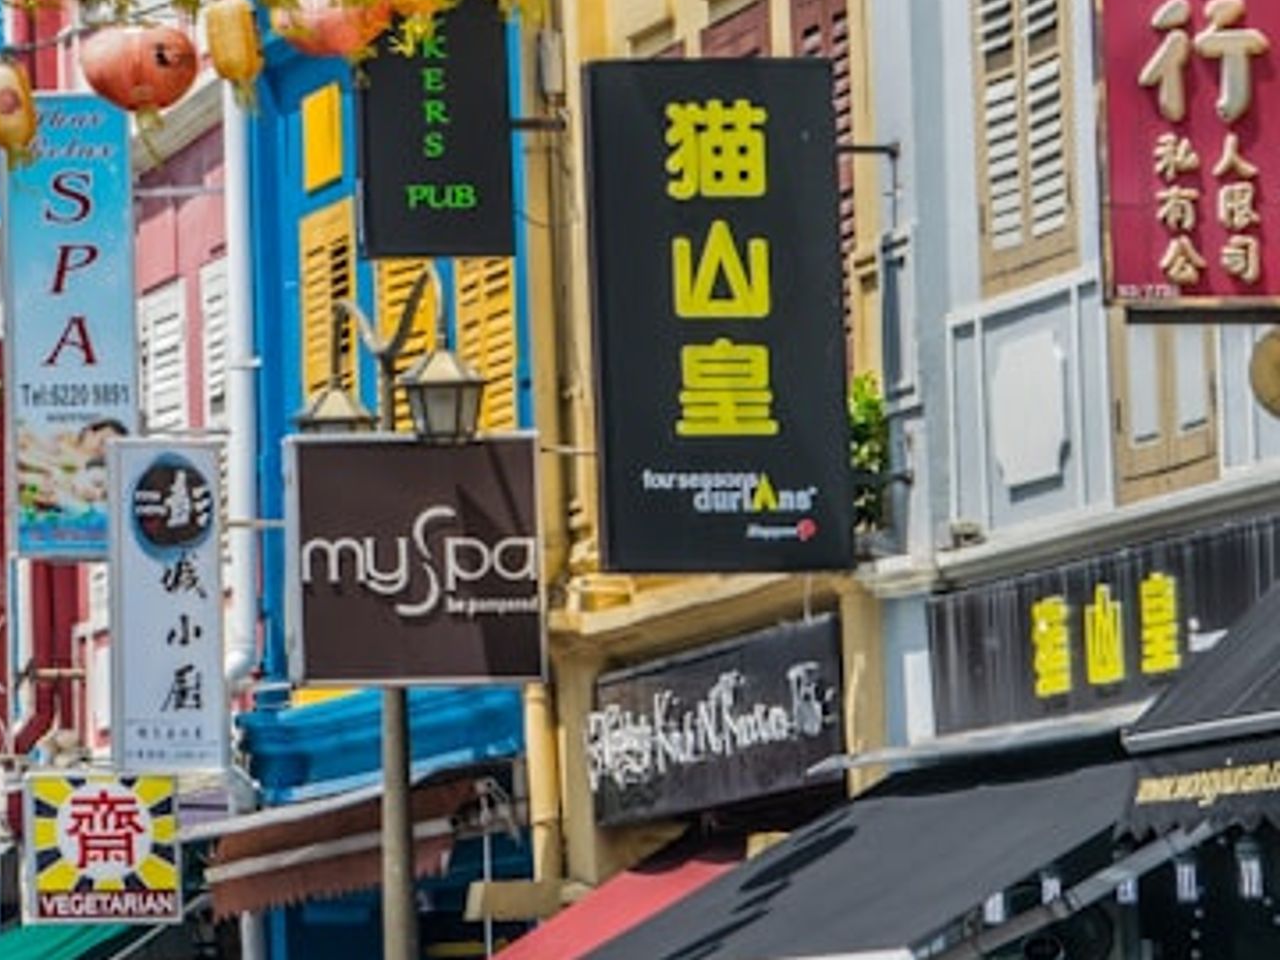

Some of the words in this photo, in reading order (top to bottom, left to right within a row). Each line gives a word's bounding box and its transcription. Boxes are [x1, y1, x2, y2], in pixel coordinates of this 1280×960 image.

[406, 183, 477, 210] PUB
[665, 99, 780, 436] 猫山皇
[42, 891, 175, 916] VEGETARIAN
